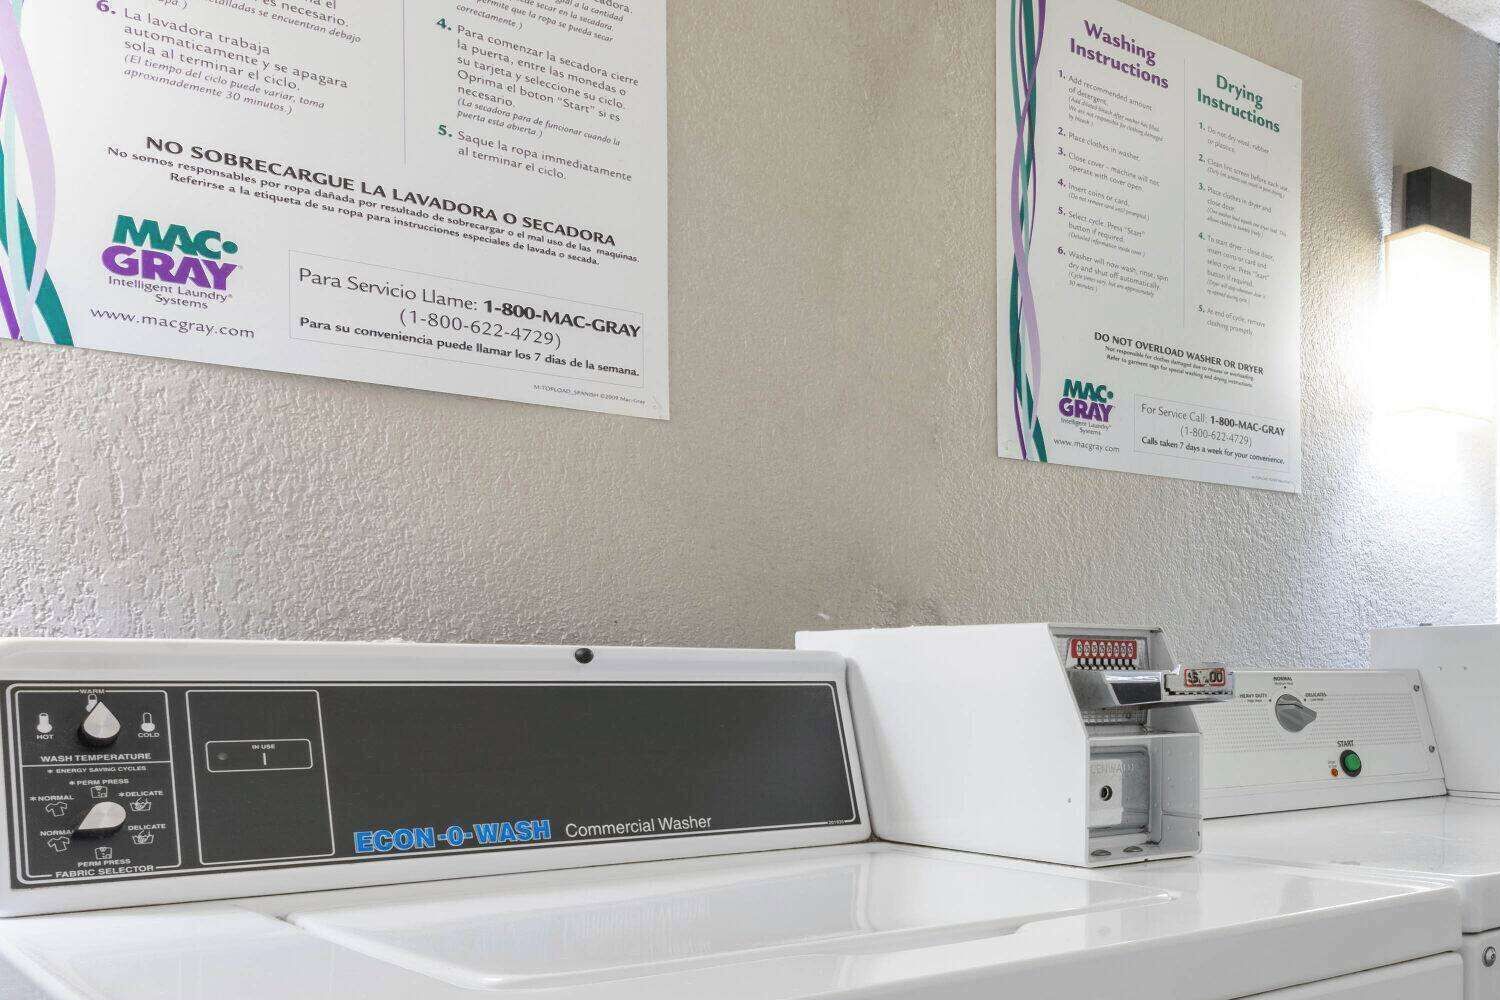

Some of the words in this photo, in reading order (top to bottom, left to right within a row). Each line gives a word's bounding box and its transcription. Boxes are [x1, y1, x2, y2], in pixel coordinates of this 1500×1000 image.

[125, 8, 141, 21] La
[148, 13, 212, 40] lavadora
[219, 35, 270, 54] trabaja
[1083, 19, 1156, 66] Washing
[125, 26, 260, 65] automaticamente
[263, 61, 269, 70] y
[274, 64, 287, 73] se
[293, 69, 347, 88] apagara
[125, 41, 155, 55] sola
[162, 50, 173, 59] al
[180, 54, 243, 75] terminar
[248, 70, 258, 80] el
[263, 69, 299, 90] ciclo.
[1070, 38, 1169, 89] Instructions
[1197, 88, 1280, 133] Instructions
[1216, 74, 1263, 110] Drying
[438, 124, 453, 137] 5.
[458, 131, 493, 149] Saque
[497, 140, 507, 151] la
[512, 147, 539, 158] ropa
[542, 154, 631, 181] immediatamente
[458, 147, 468, 156] al
[473, 151, 522, 168] terminar
[538, 168, 566, 179] ciclo.
[147, 137, 183, 154] NO
[191, 146, 354, 190] SOBRECARGUE
[362, 182, 386, 198] LA
[393, 189, 497, 221] LAVADORA
[503, 213, 517, 224] O
[523, 217, 615, 246] SECADORA
[102, 245, 238, 290] GRAY
[109, 275, 173, 293] Intelligent
[178, 286, 228, 302] Laundry
[155, 293, 208, 309] Systems
[300, 268, 341, 288] Para
[348, 276, 416, 299] Servicio
[423, 289, 476, 310] Llame:
[484, 300, 640, 337] 1-800-MAC-GRAY
[90, 308, 255, 338] www.macgray.com
[400, 309, 561, 350] (1-800-622-4729)
[301, 317, 331, 330] Para
[355, 328, 433, 345] conveniencia
[437, 341, 472, 351] puede
[476, 343, 512, 357] llamar
[516, 349, 531, 360] los
[535, 353, 541, 361] 7
[545, 354, 566, 365] dias
[570, 358, 582, 367] de
[586, 360, 594, 370] la
[598, 365, 639, 376] semana.
[1095, 332, 1109, 342] DO
[1112, 336, 1132, 346] NOT
[1136, 341, 1184, 357] OVERLOAD
[1187, 352, 1221, 366] WASHER
[1224, 360, 1235, 369] OR
[1238, 363, 1263, 375] DRYER
[1058, 397, 1114, 423] GRAY
[1142, 404, 1156, 414] For
[1158, 407, 1187, 419] Service
[1190, 412, 1207, 423] Call:
[1211, 416, 1285, 436] 1-800-MAC-GRAY
[1054, 438, 1119, 452] www.macgray.com
[1142, 436, 1158, 445] Calls
[1160, 440, 1178, 448] taken
[1186, 443, 1200, 453] days
[1249, 455, 1284, 464] convenience.
[1180, 426, 1251, 447] (1-800-622-4729)
[566, 818, 654, 837] Commercial
[658, 816, 712, 832] Washer
[56, 869, 95, 878] FABRIC
[97, 866, 154, 876] SELECTOR
